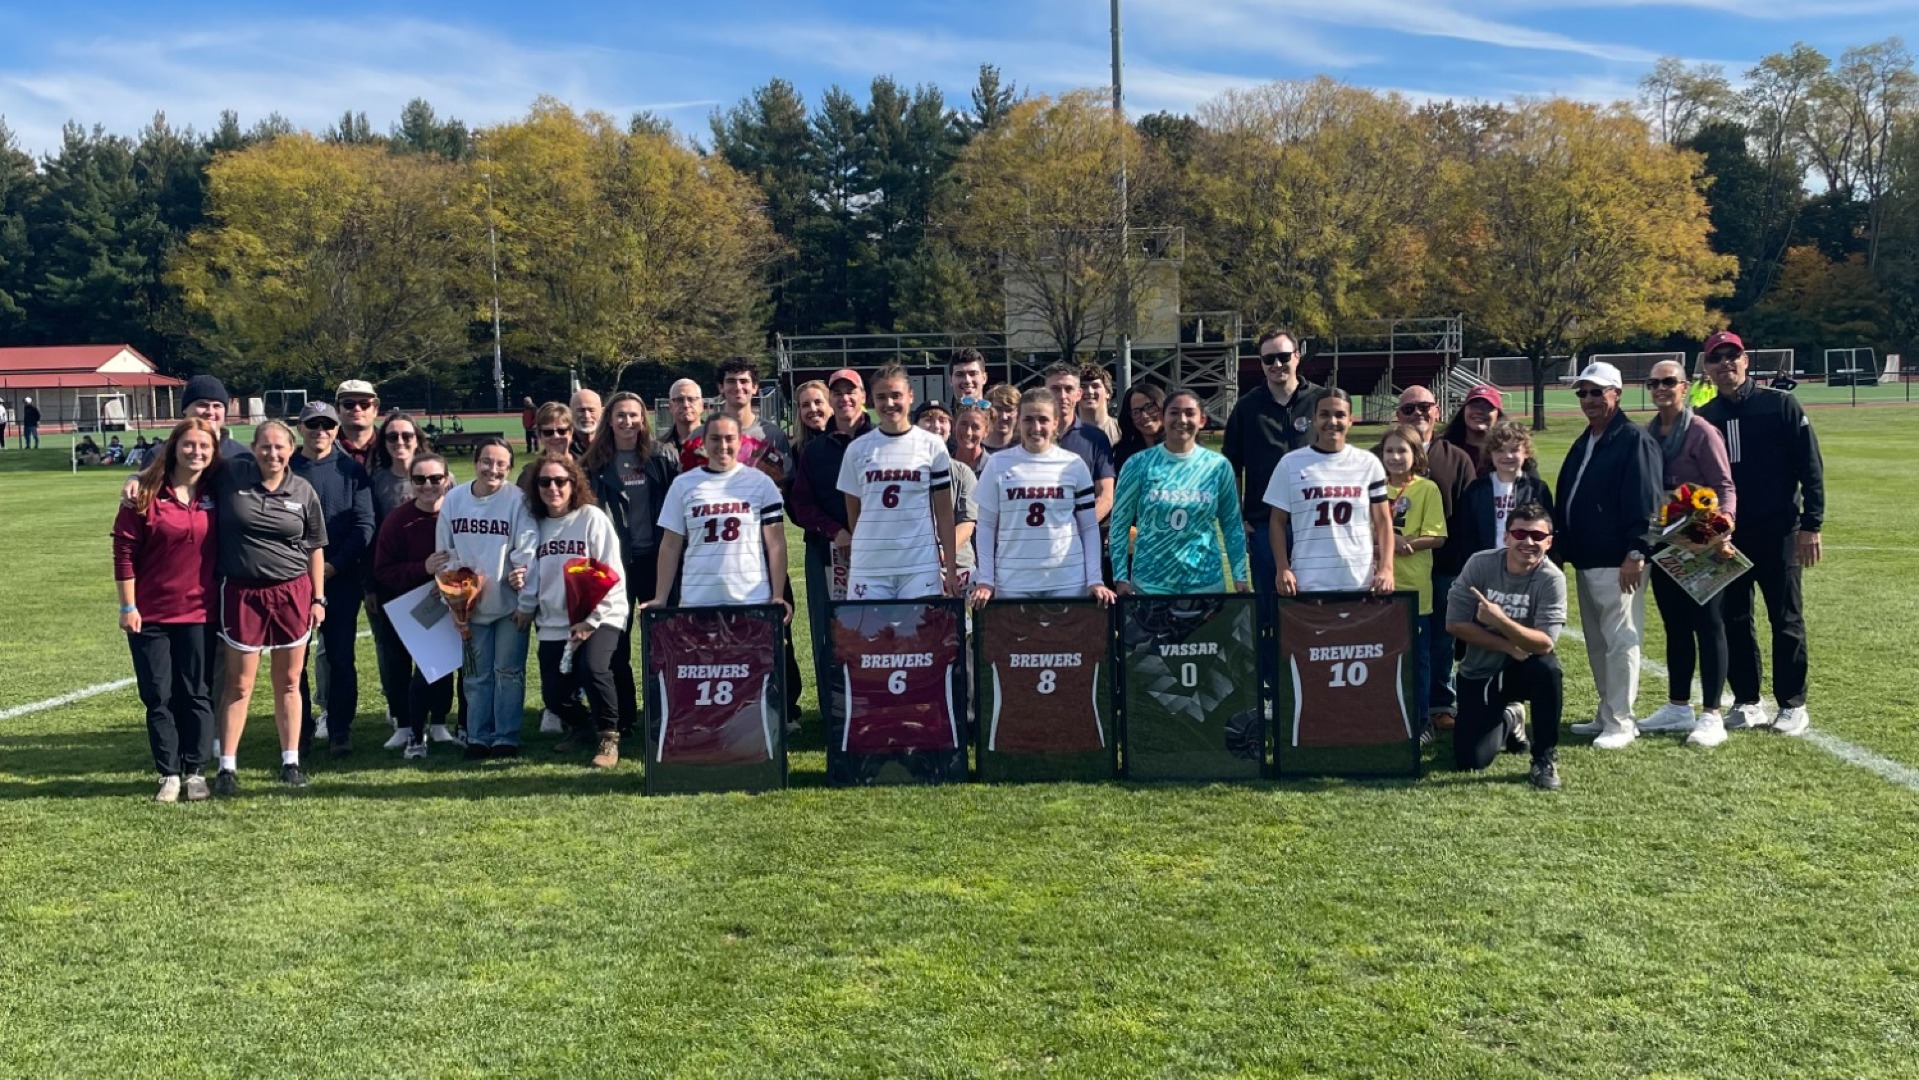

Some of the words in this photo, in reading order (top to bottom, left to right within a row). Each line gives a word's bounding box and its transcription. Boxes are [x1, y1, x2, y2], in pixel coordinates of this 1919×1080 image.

[865, 469, 921, 483] VASSAR
[882, 484, 901, 509] 6
[1006, 486, 1065, 500] VASSAR
[1149, 489, 1211, 504] VASSAR
[1301, 486, 1363, 500] VASSAR
[691, 501, 751, 518] VASSAR
[1026, 502, 1046, 527] 8
[1314, 500, 1353, 527] 10
[451, 517, 510, 536] VASSAR
[1170, 508, 1188, 531] 0
[704, 516, 741, 543] 18
[1158, 641, 1219, 657] VASSAR
[1309, 643, 1384, 662] BREWERS
[861, 652, 934, 669] BREWERS
[1010, 652, 1082, 668] BREWERS
[677, 663, 750, 679] BREWERS
[1181, 662, 1198, 687] 0
[1328, 661, 1369, 688] 10
[887, 670, 908, 695] 6
[1037, 669, 1057, 694] 8
[695, 680, 734, 706] 18
